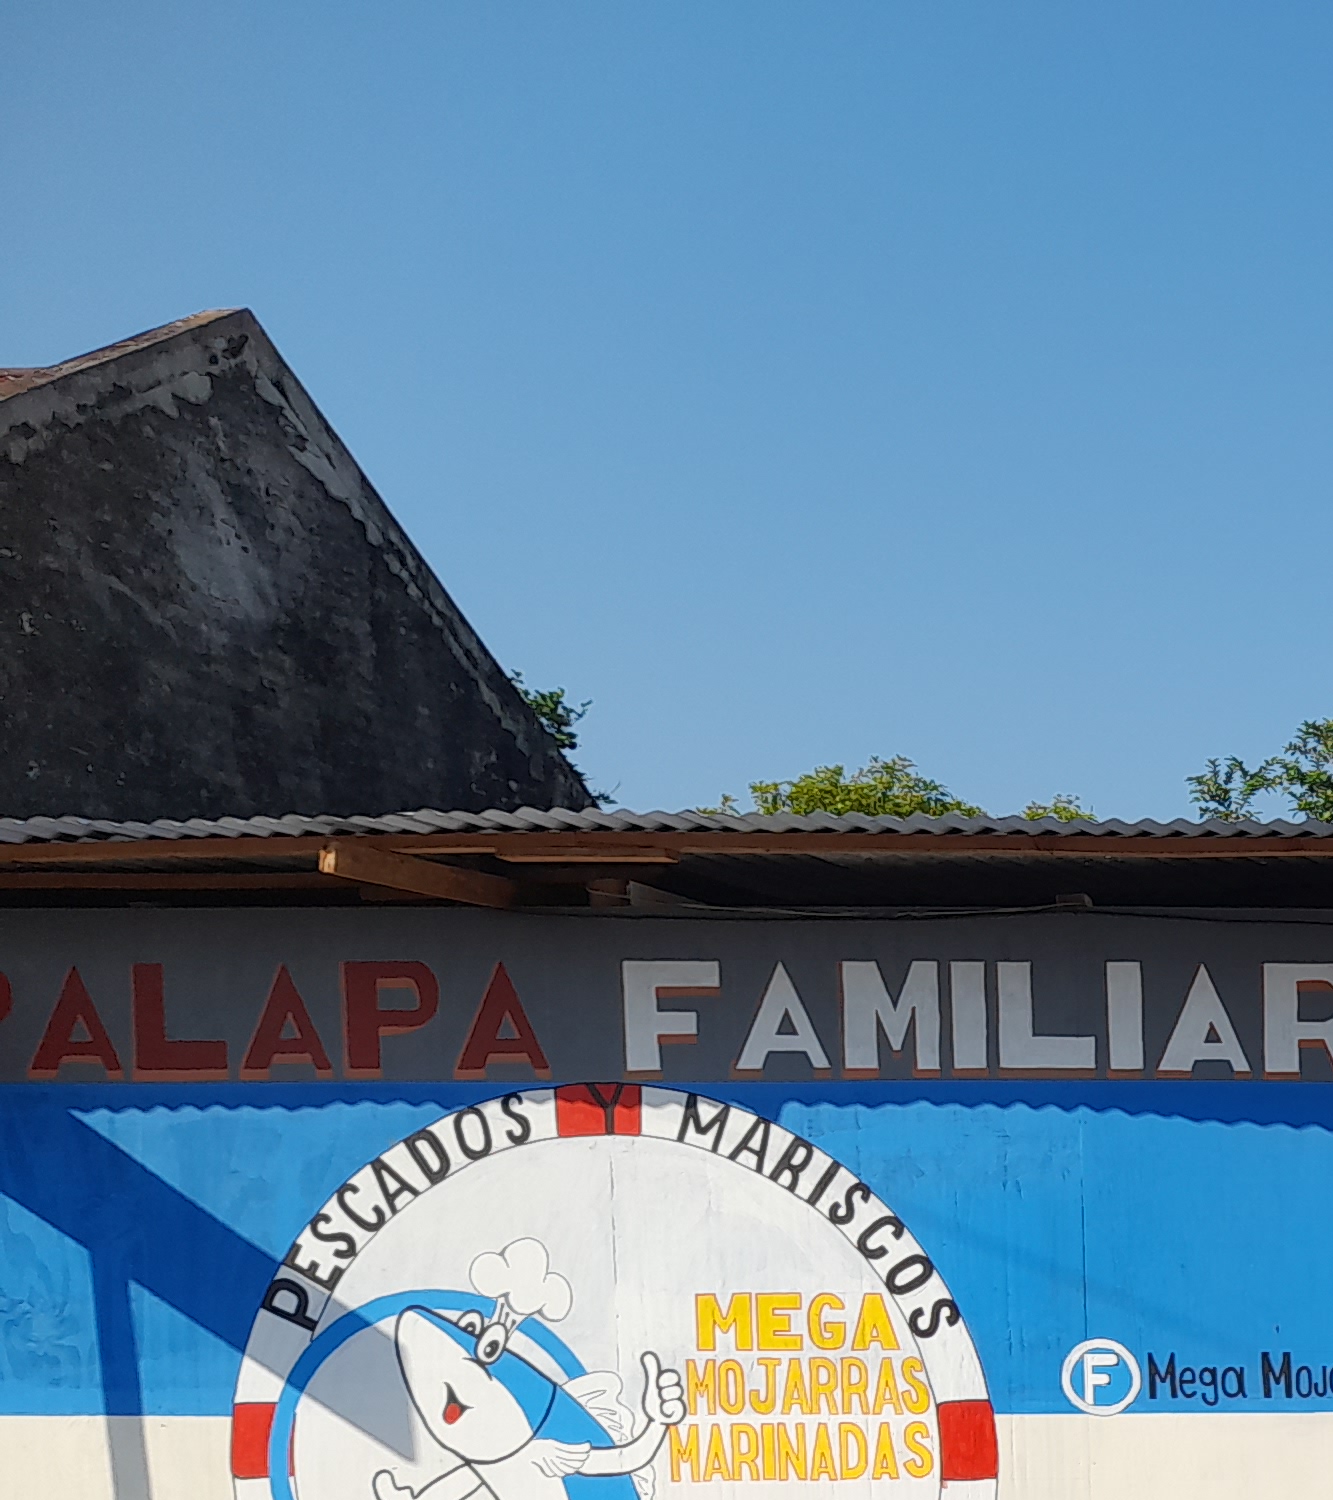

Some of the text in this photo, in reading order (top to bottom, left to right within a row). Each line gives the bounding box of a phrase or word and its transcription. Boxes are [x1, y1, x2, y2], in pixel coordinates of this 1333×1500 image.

[0, 960, 552, 1080] ALAPA
[262, 1083, 959, 1339] PESCADOS Y MARISCOS
[695, 1292, 900, 1351] MEGA
[686, 1356, 931, 1415] MOJARRAS
[1147, 1352, 1248, 1406] Mega
[669, 1421, 934, 1482] MARINADAS
